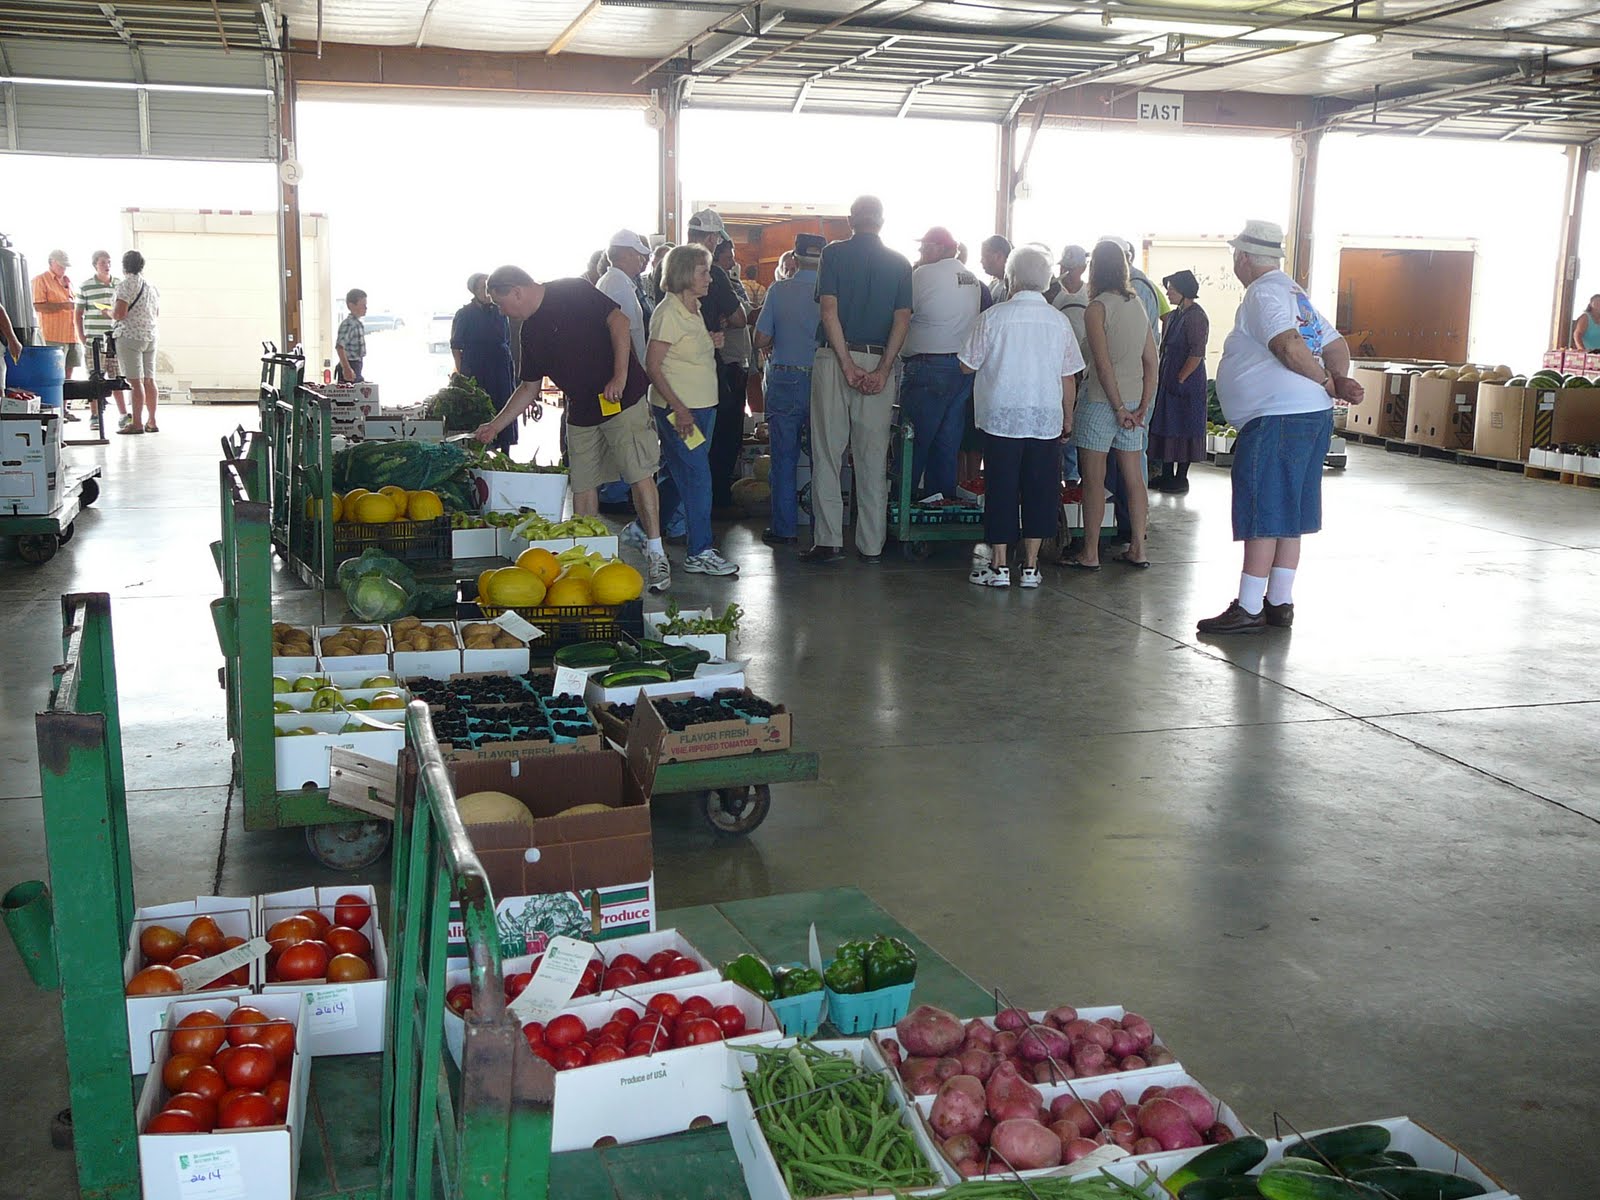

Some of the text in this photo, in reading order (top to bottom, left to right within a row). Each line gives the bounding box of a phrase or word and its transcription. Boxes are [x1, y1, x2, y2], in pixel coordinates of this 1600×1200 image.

[649, 109, 658, 126] 3
[1140, 103, 1181, 121] EAST
[1295, 140, 1304, 157] 5
[286, 163, 299, 180] 2
[1021, 182, 1033, 200] 4
[680, 728, 750, 744] FLAVOR FRESH
[478, 747, 556, 760] FLAVOR FRESH
[671, 738, 758, 755] VINE RIPENED TOMATOES
[315, 1001, 345, 1016] 2614
[620, 1069, 668, 1086] Produce of USA
[190, 1169, 221, 1183] 2614
